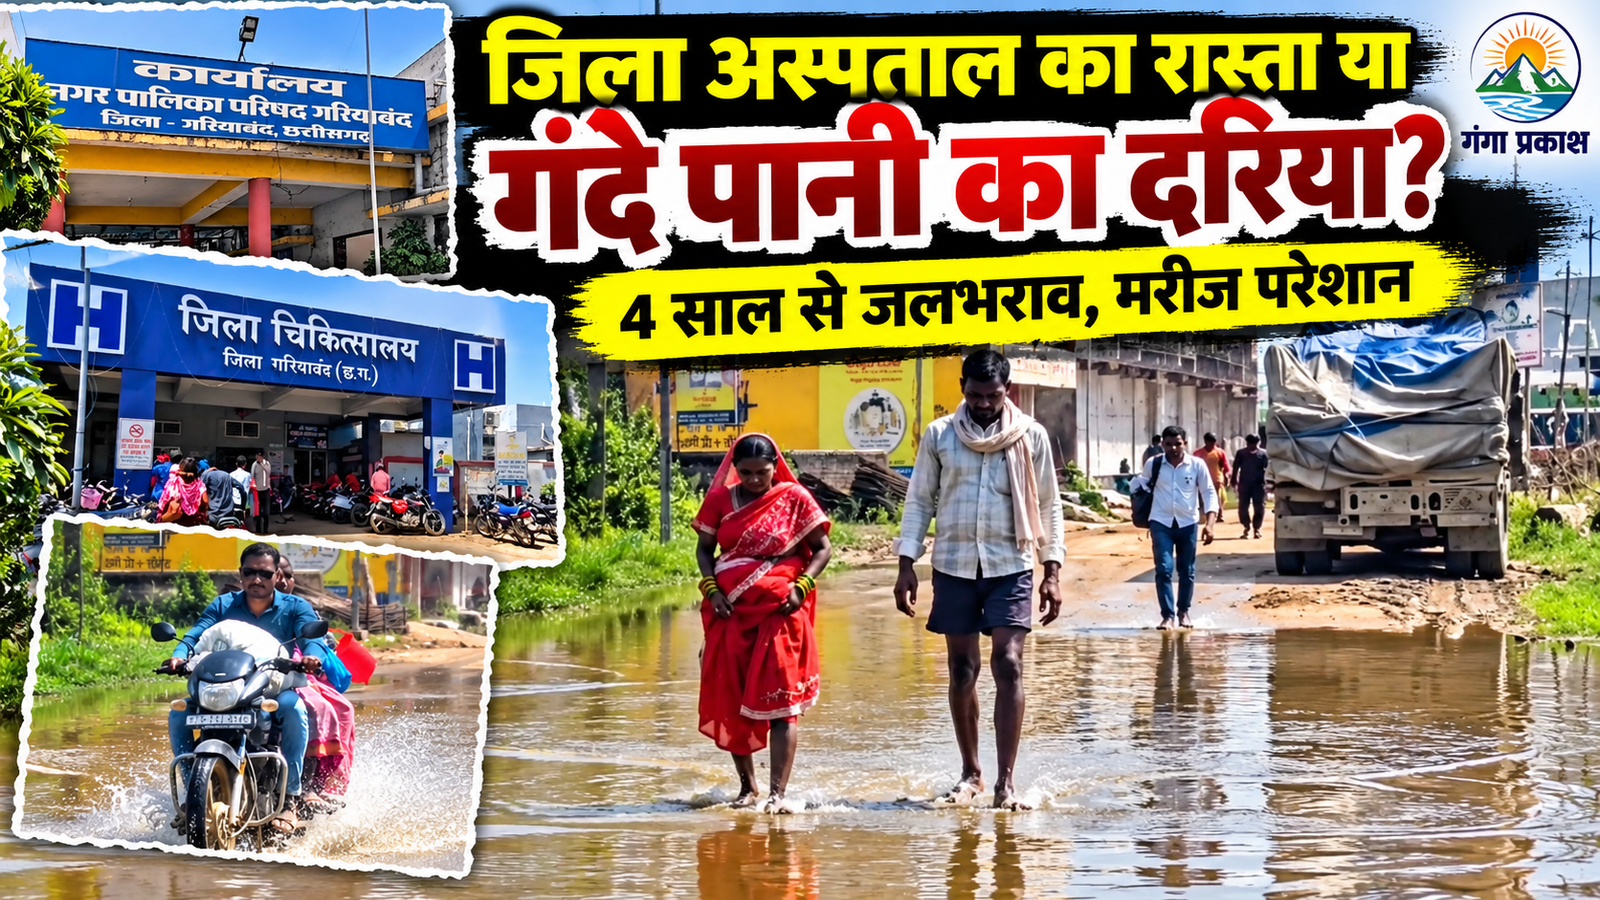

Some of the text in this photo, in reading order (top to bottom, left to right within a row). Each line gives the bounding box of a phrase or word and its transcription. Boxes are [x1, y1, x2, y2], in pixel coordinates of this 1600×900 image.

[133, 59, 347, 97] कार्यालय
[101, 109, 161, 128] जिला
[116, 86, 224, 113] पालिका
[229, 94, 308, 121] परिषद
[178, 293, 419, 363] जिला चिकित्सालय
[223, 347, 262, 369] जिला
